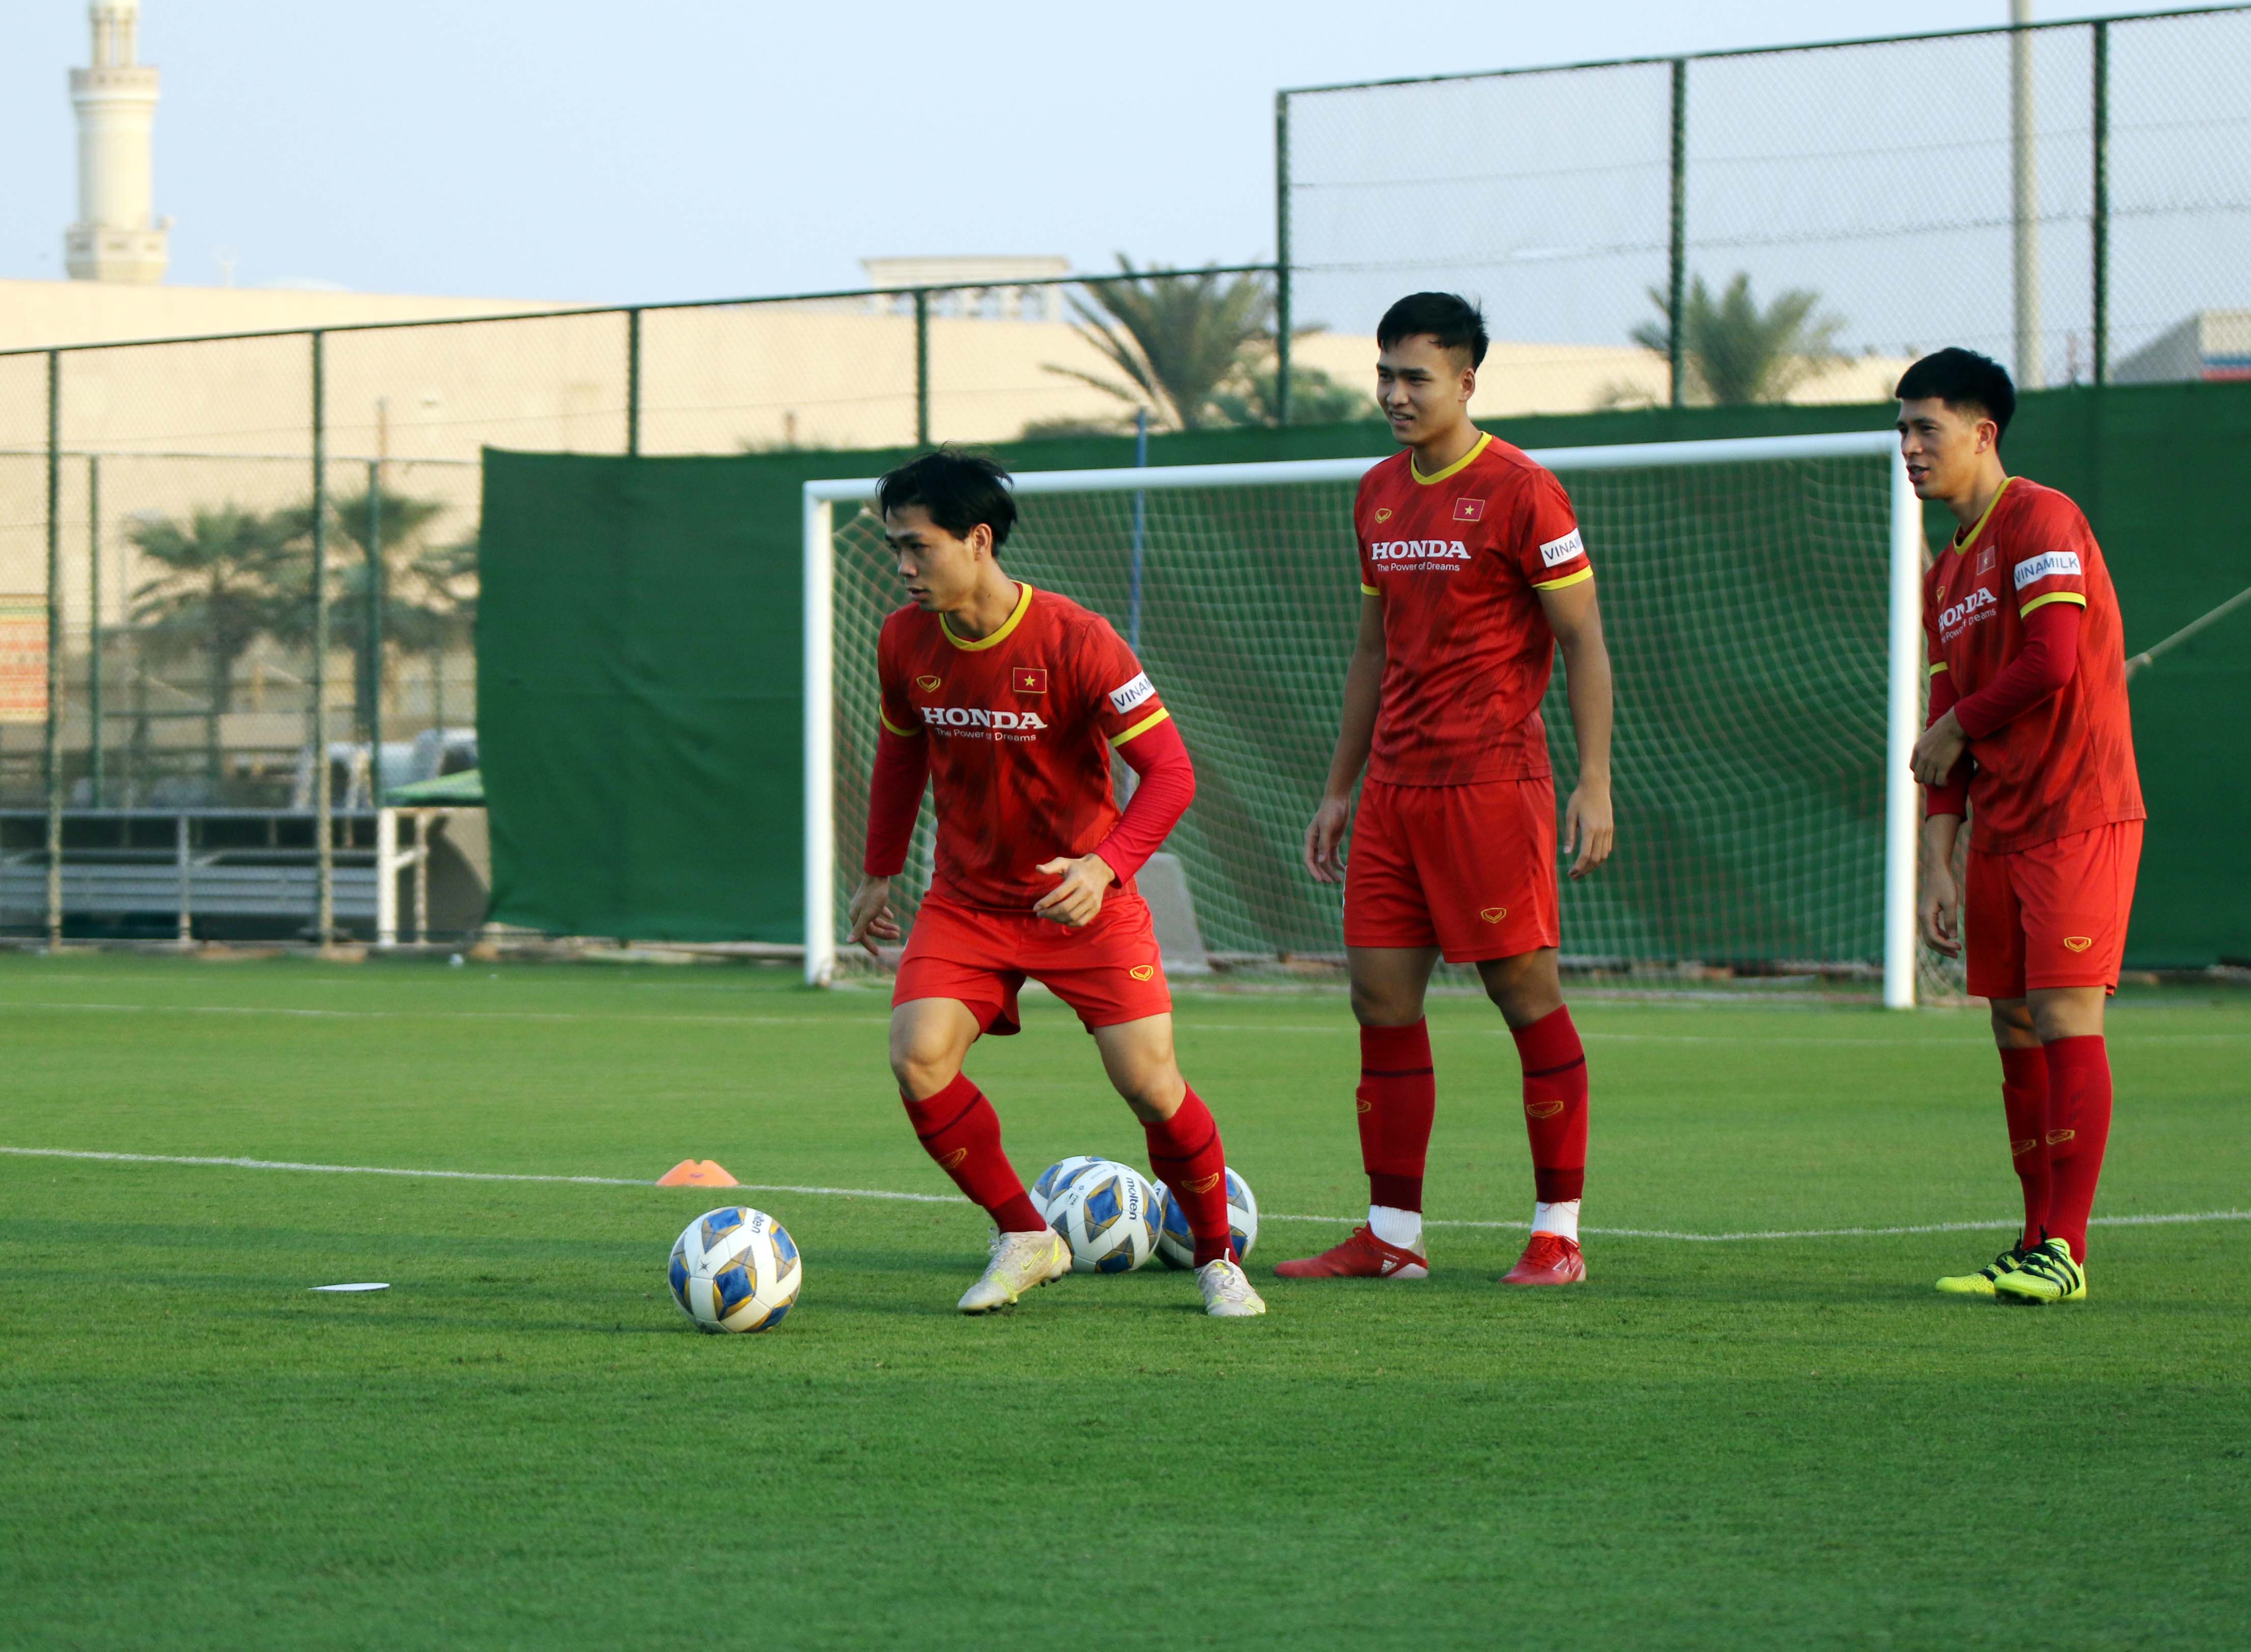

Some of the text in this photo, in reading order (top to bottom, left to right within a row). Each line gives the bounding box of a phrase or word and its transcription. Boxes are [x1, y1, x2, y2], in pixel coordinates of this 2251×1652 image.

[1371, 539, 1472, 560] HONDA
[1377, 561, 1460, 572] The Power of Dreams
[2015, 557, 2078, 583] VINAMILK
[920, 706, 1048, 729] HONDA
[935, 727, 952, 737] The
[953, 728, 985, 738] Power
[994, 732, 1037, 742] Dreams
[1126, 1177, 1139, 1220] molten
